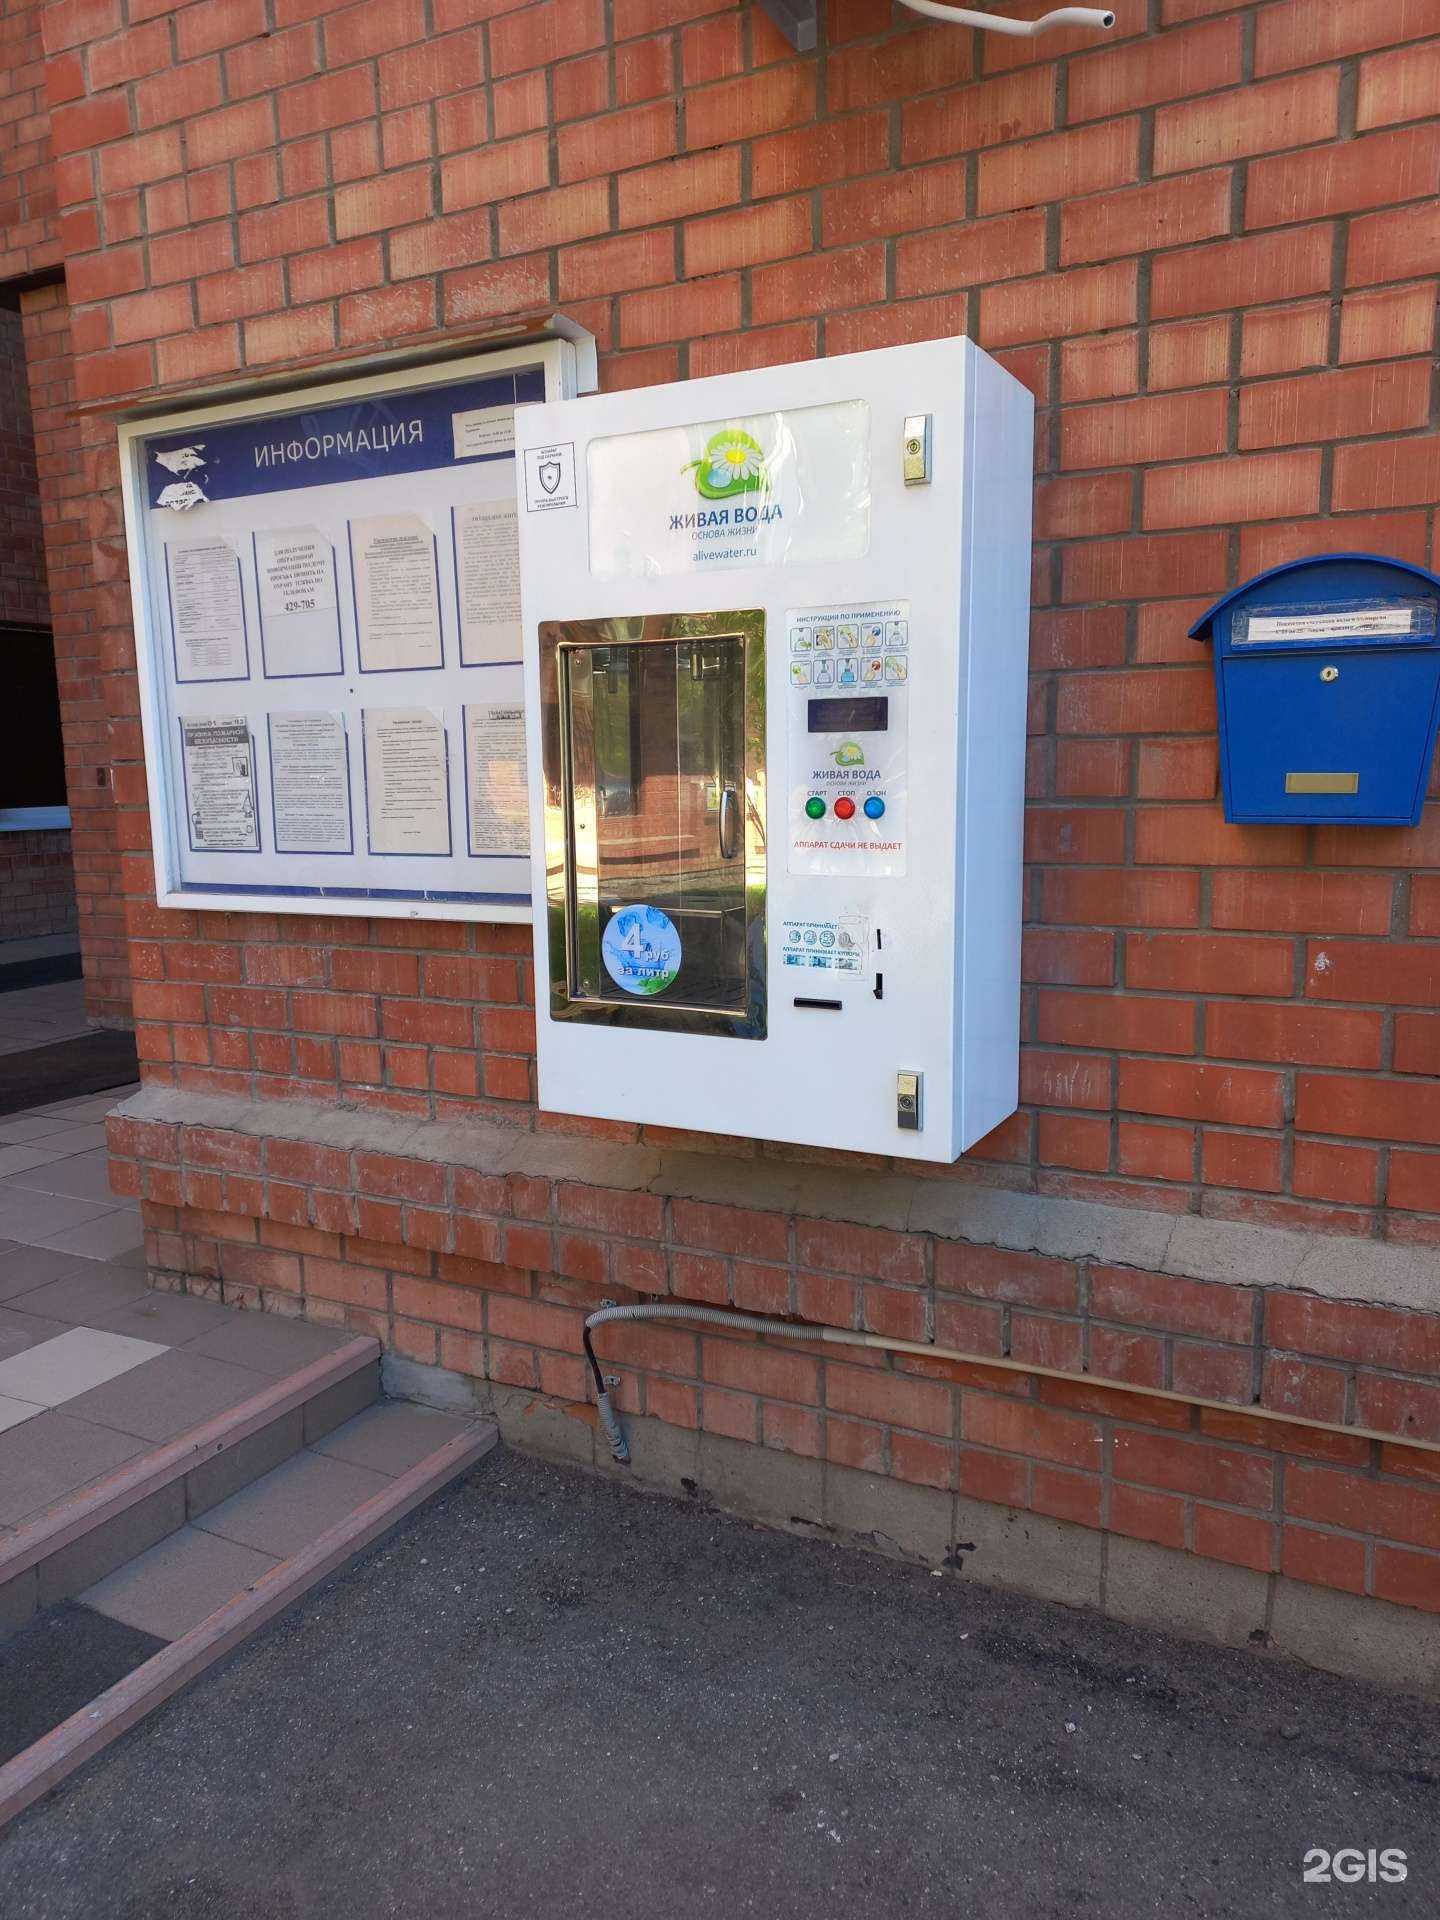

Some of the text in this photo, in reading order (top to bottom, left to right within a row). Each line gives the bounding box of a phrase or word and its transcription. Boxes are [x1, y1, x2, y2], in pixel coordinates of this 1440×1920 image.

[254, 419, 423, 468] ИНФОРМАЦИЯ
[669, 504, 783, 530] ЖИВАЯ ВОДА
[691, 529, 725, 540] ОСНОВА
[692, 548, 757, 561] alivewater.ru
[285, 599, 316, 611] 429-705
[851, 610, 901, 619] ПРИМЕНЕНИЮ
[812, 770, 881, 780] ЖИВАЯ ВОДА
[794, 841, 829, 849] АППАРАТ
[830, 841, 856, 850] СДАЧИ
[870, 842, 903, 851] ВЫДАЕТ
[622, 922, 670, 961] 4 руб
[617, 967, 669, 978] за литр
